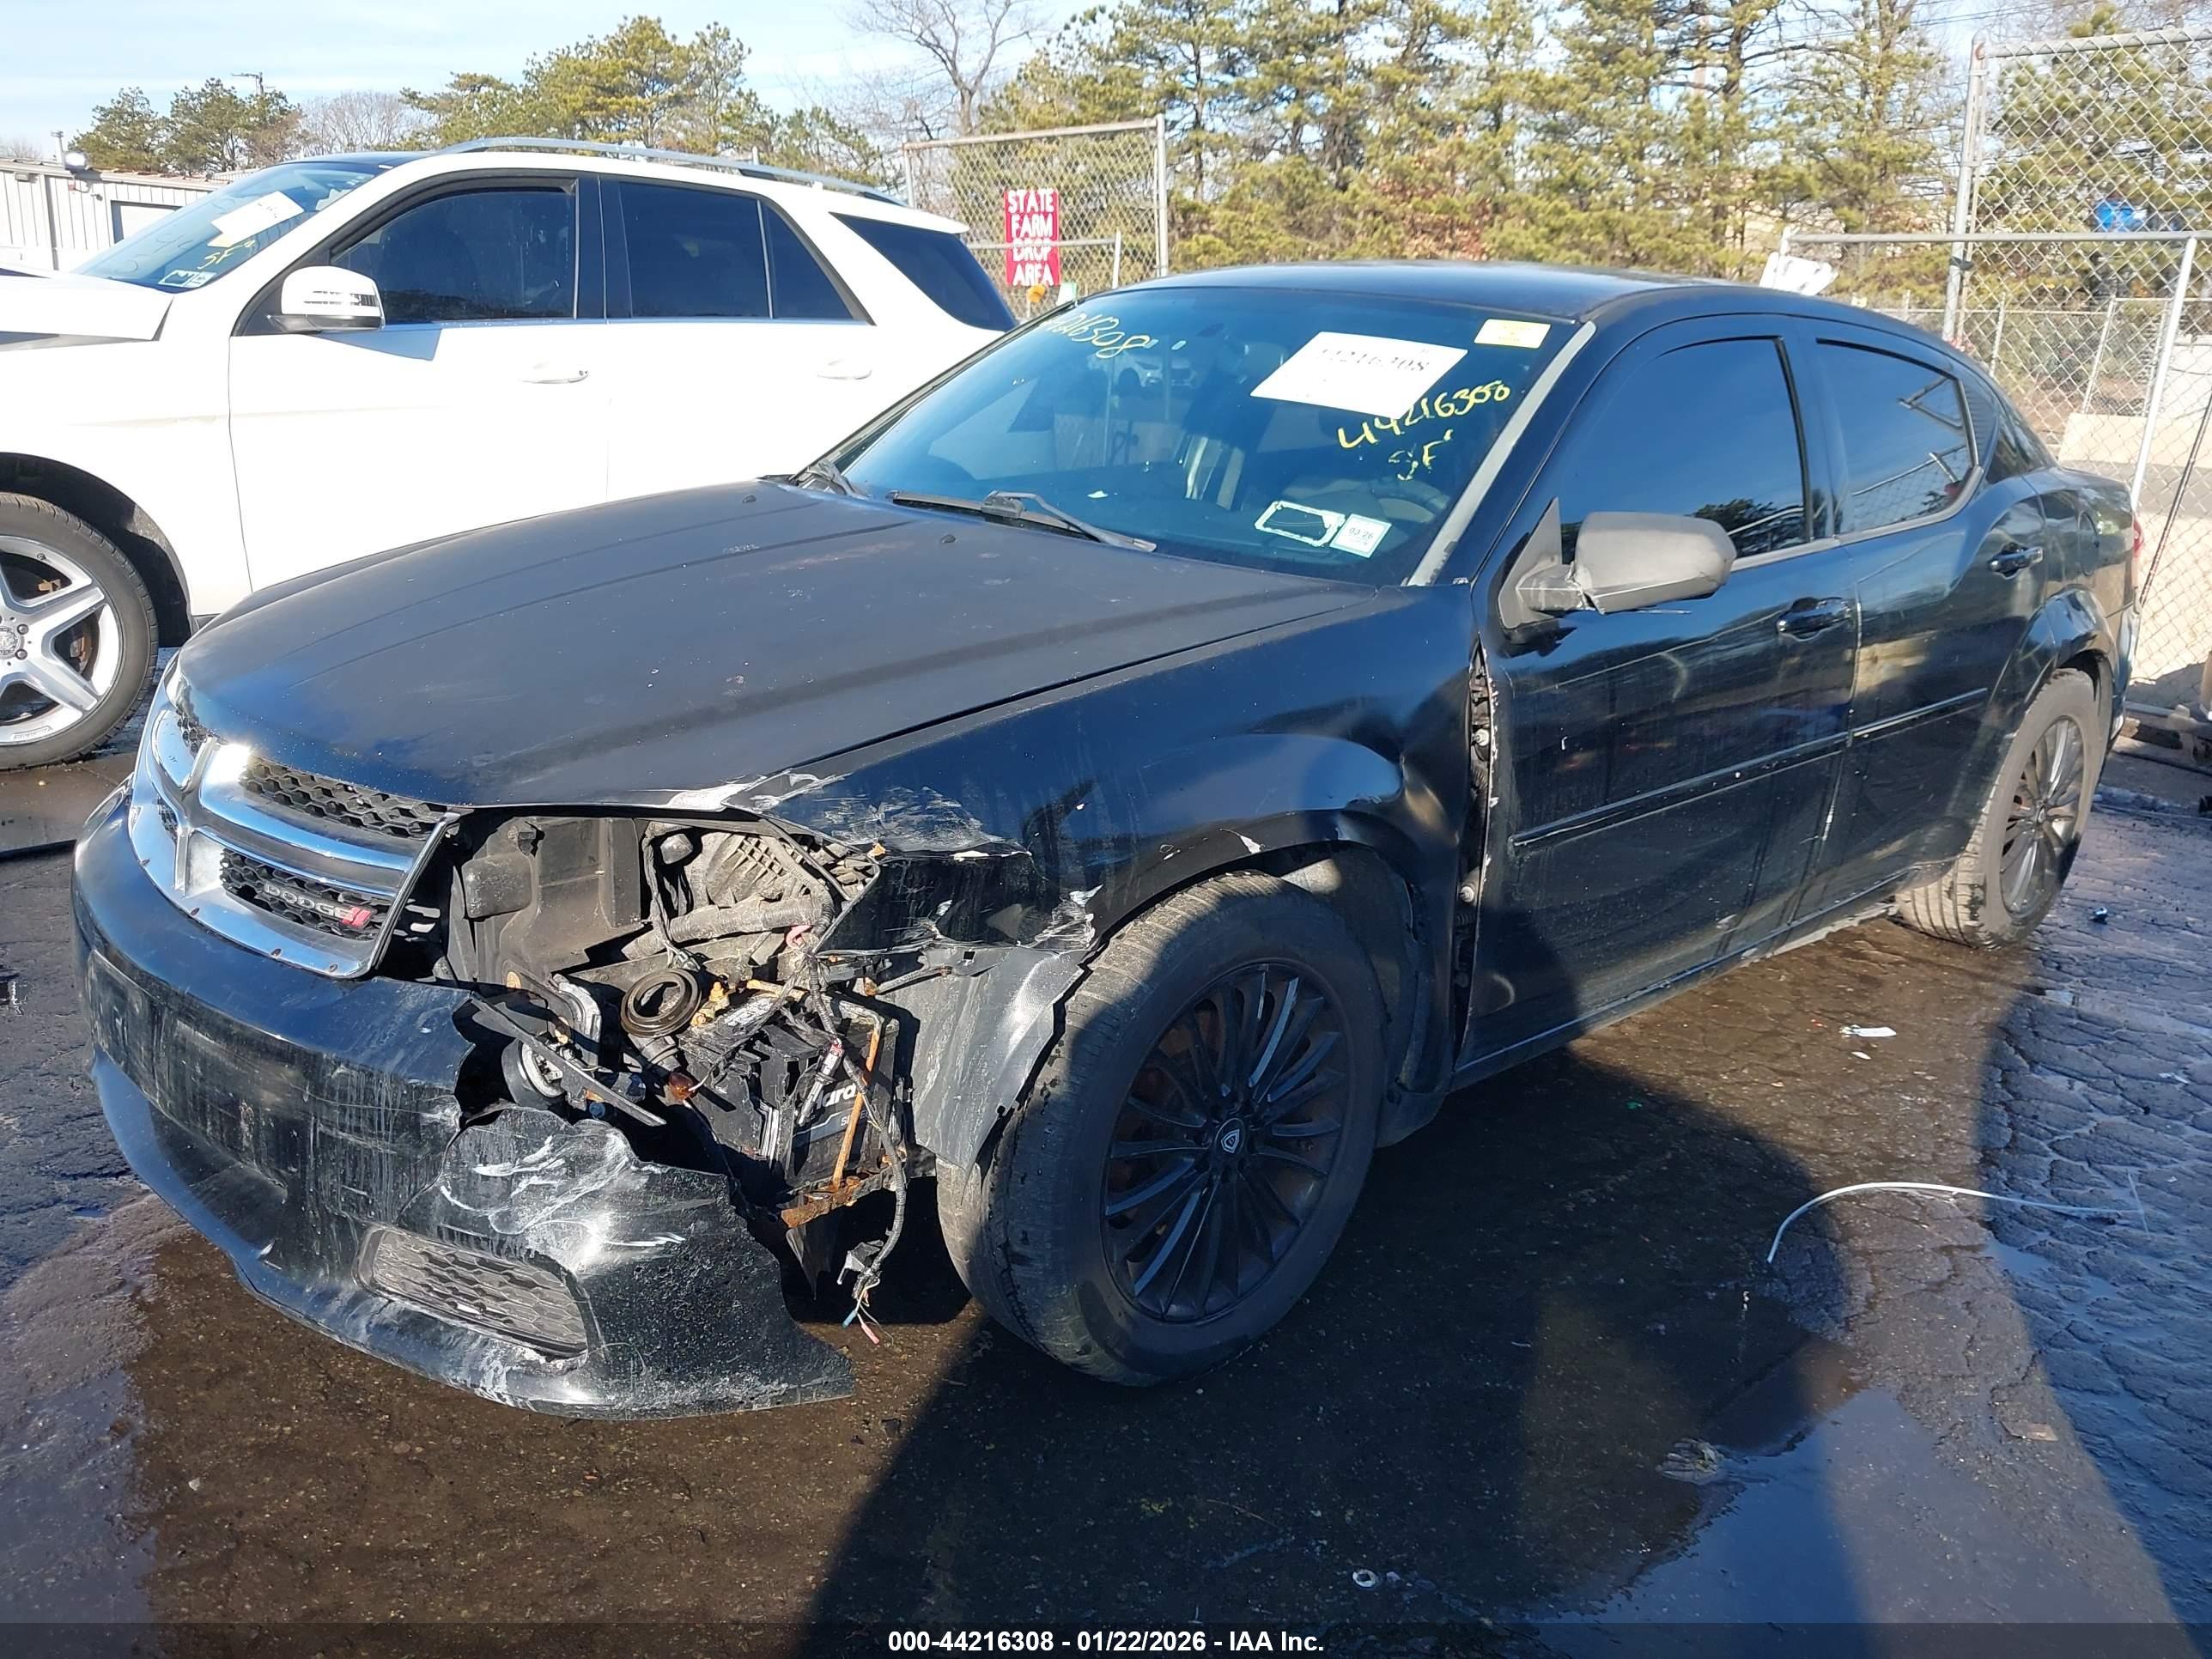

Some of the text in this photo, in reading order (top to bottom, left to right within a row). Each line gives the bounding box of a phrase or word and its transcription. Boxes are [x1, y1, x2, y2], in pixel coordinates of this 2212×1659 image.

[1008, 188, 1054, 214] STATE
[1012, 212, 1053, 239] FARM
[1012, 237, 1052, 262] DROP
[1012, 262, 1054, 287] AREA
[263, 883, 356, 923] DODGE
